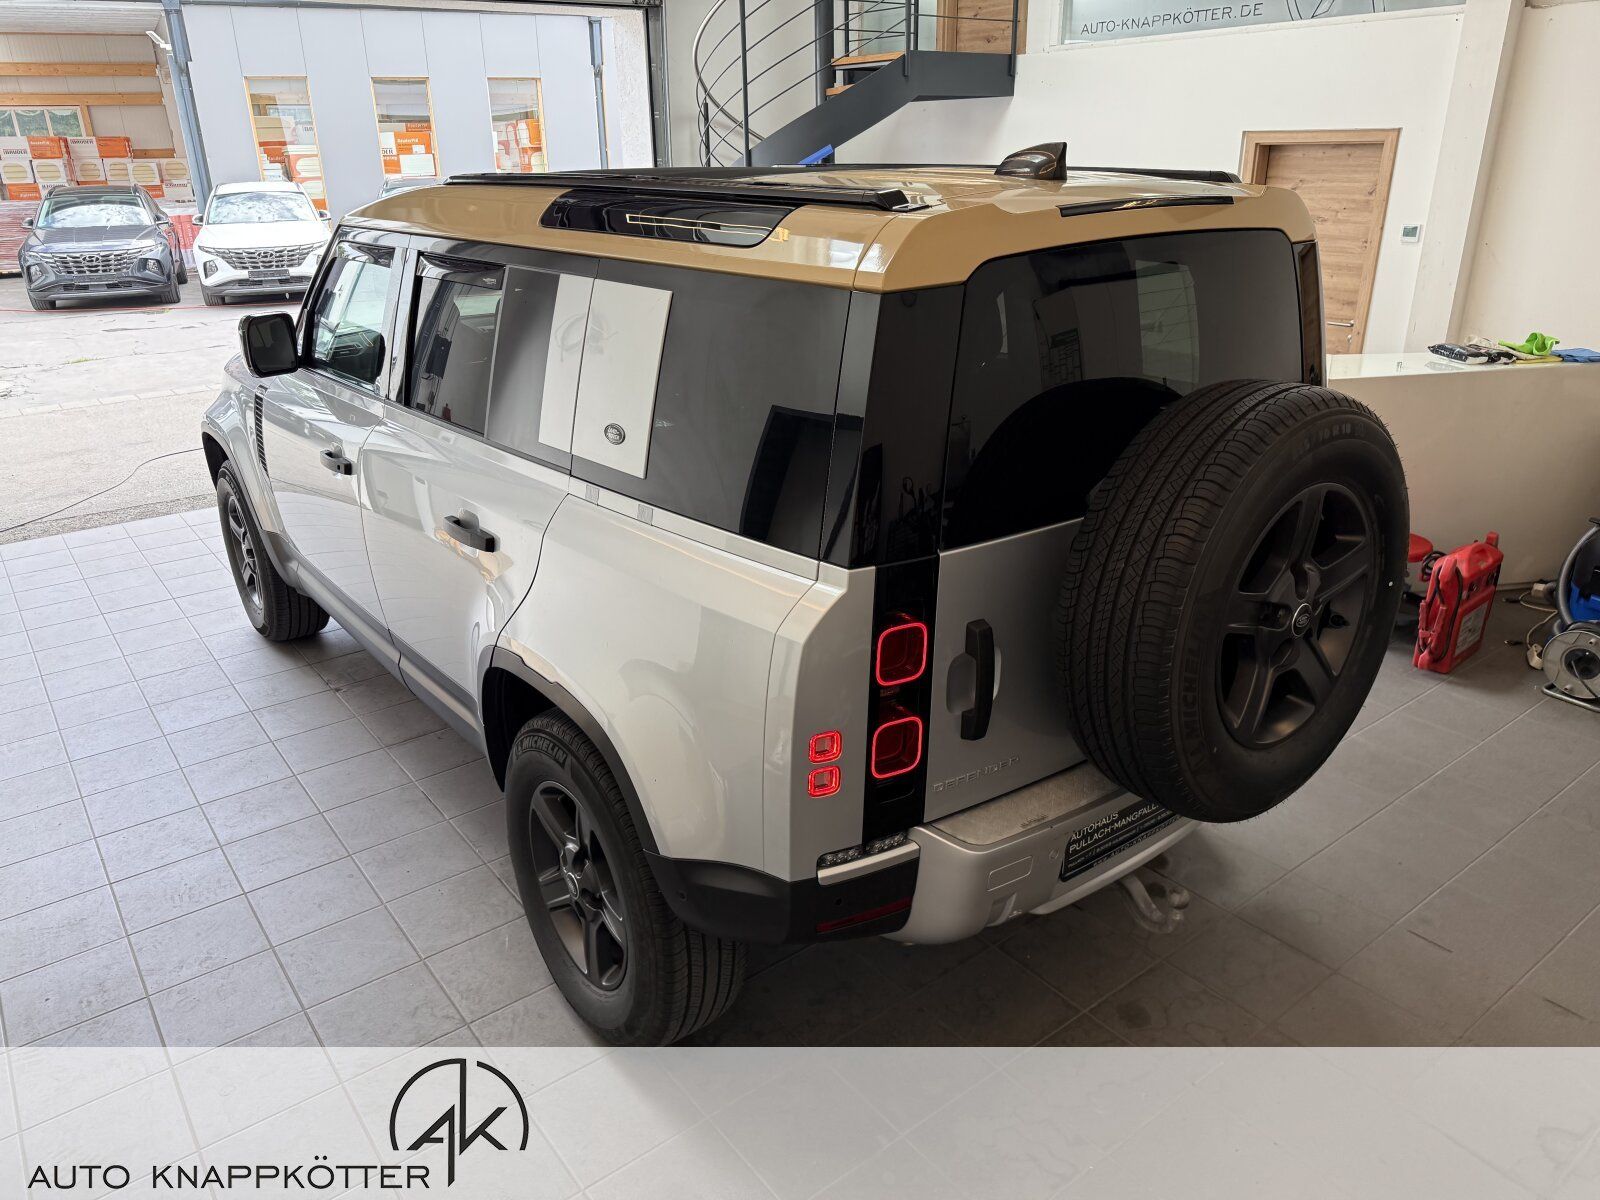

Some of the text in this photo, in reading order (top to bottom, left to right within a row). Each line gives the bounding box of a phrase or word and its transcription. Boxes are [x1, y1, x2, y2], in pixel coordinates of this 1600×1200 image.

[522, 734, 568, 765] MICHELIN
[932, 756, 1021, 793] DEFENDER
[1068, 802, 1160, 854] PULLACH-MANGFALL
[1069, 810, 1119, 842] AUTOHAUS
